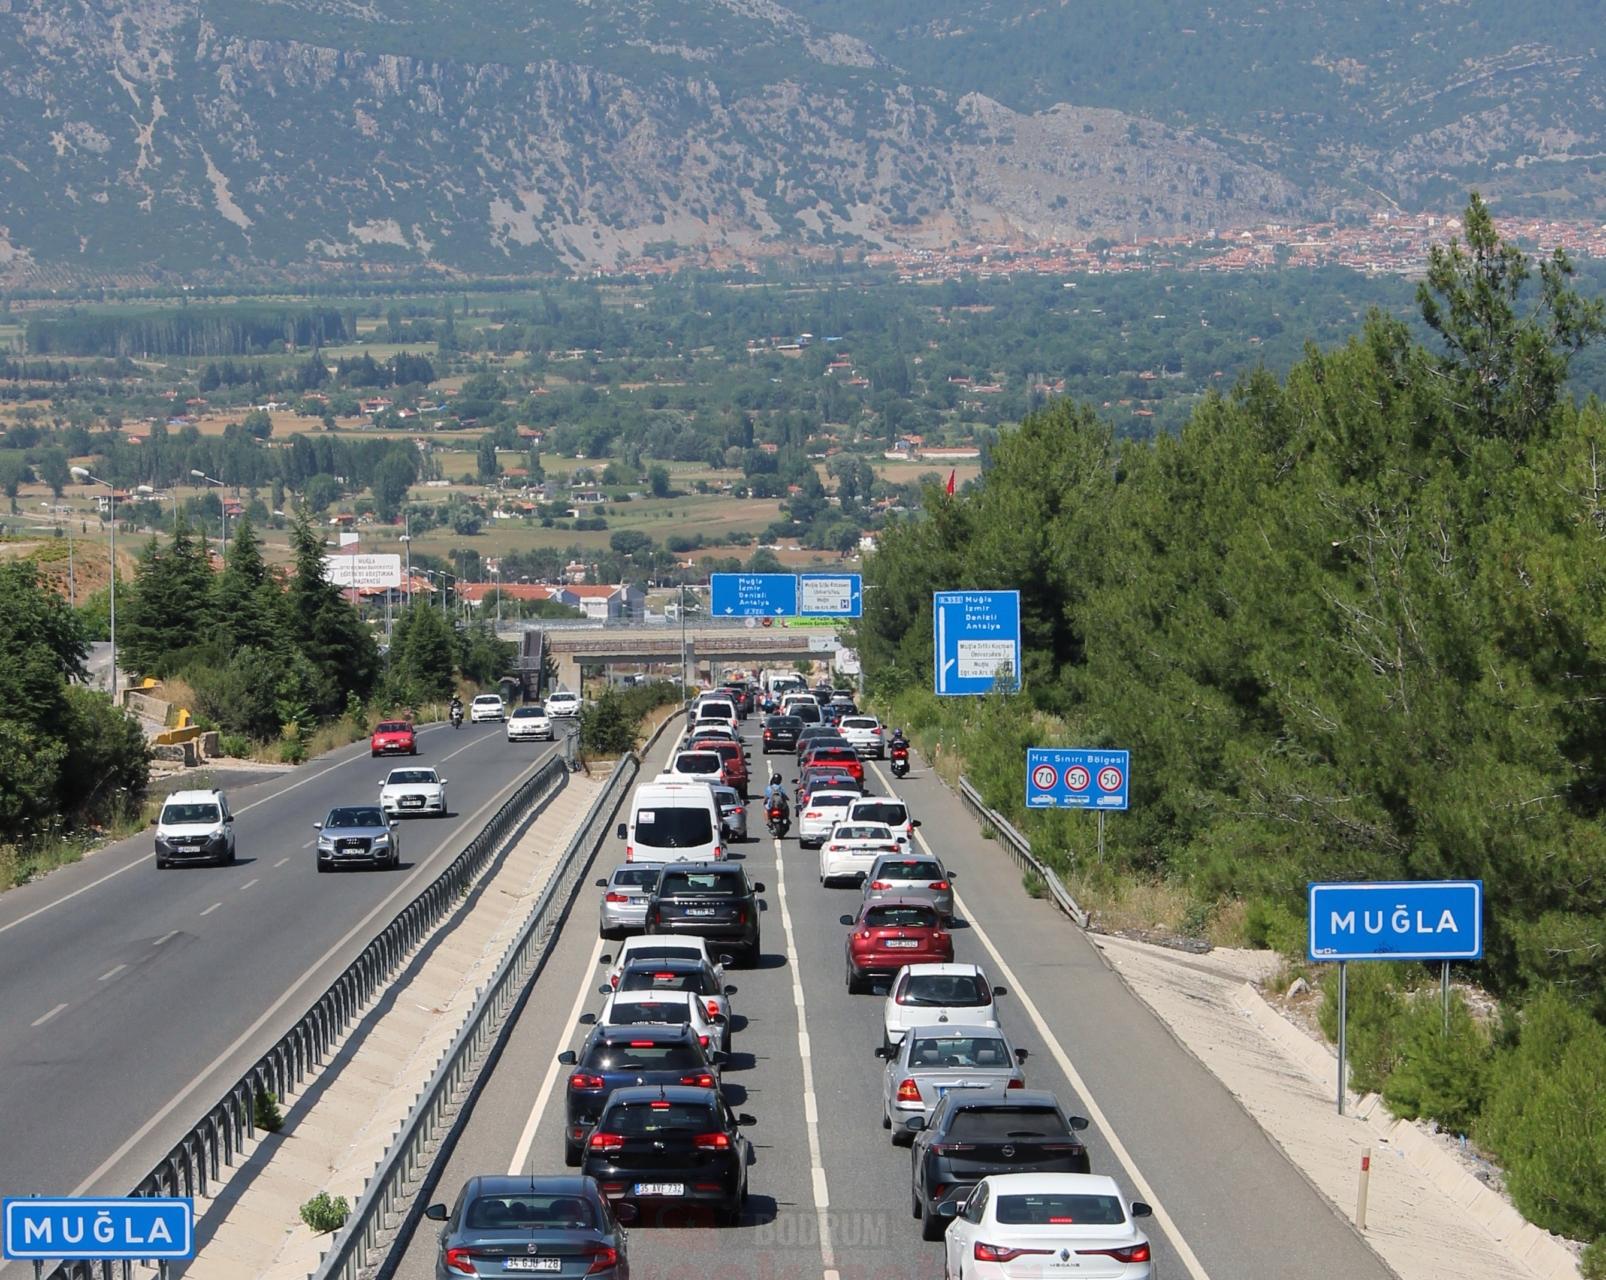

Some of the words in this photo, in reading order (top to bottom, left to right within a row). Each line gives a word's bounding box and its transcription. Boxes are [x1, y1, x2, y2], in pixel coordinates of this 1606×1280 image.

[965, 596, 992, 604] Muğla
[965, 604, 990, 612] İzmir
[966, 623, 1001, 631] Antalya
[1032, 754, 1048, 762] Hız
[1054, 755, 1082, 763] Sınırı
[1087, 755, 1124, 765] Bölgesi
[1038, 772, 1052, 784] 70
[1070, 773, 1085, 785] 50
[1103, 773, 1118, 785] 50
[1331, 904, 1458, 935] MUĞLA
[24, 1211, 172, 1244] MUĞLA
[508, 1257, 519, 1267] 34
[543, 1258, 559, 1269] 128
